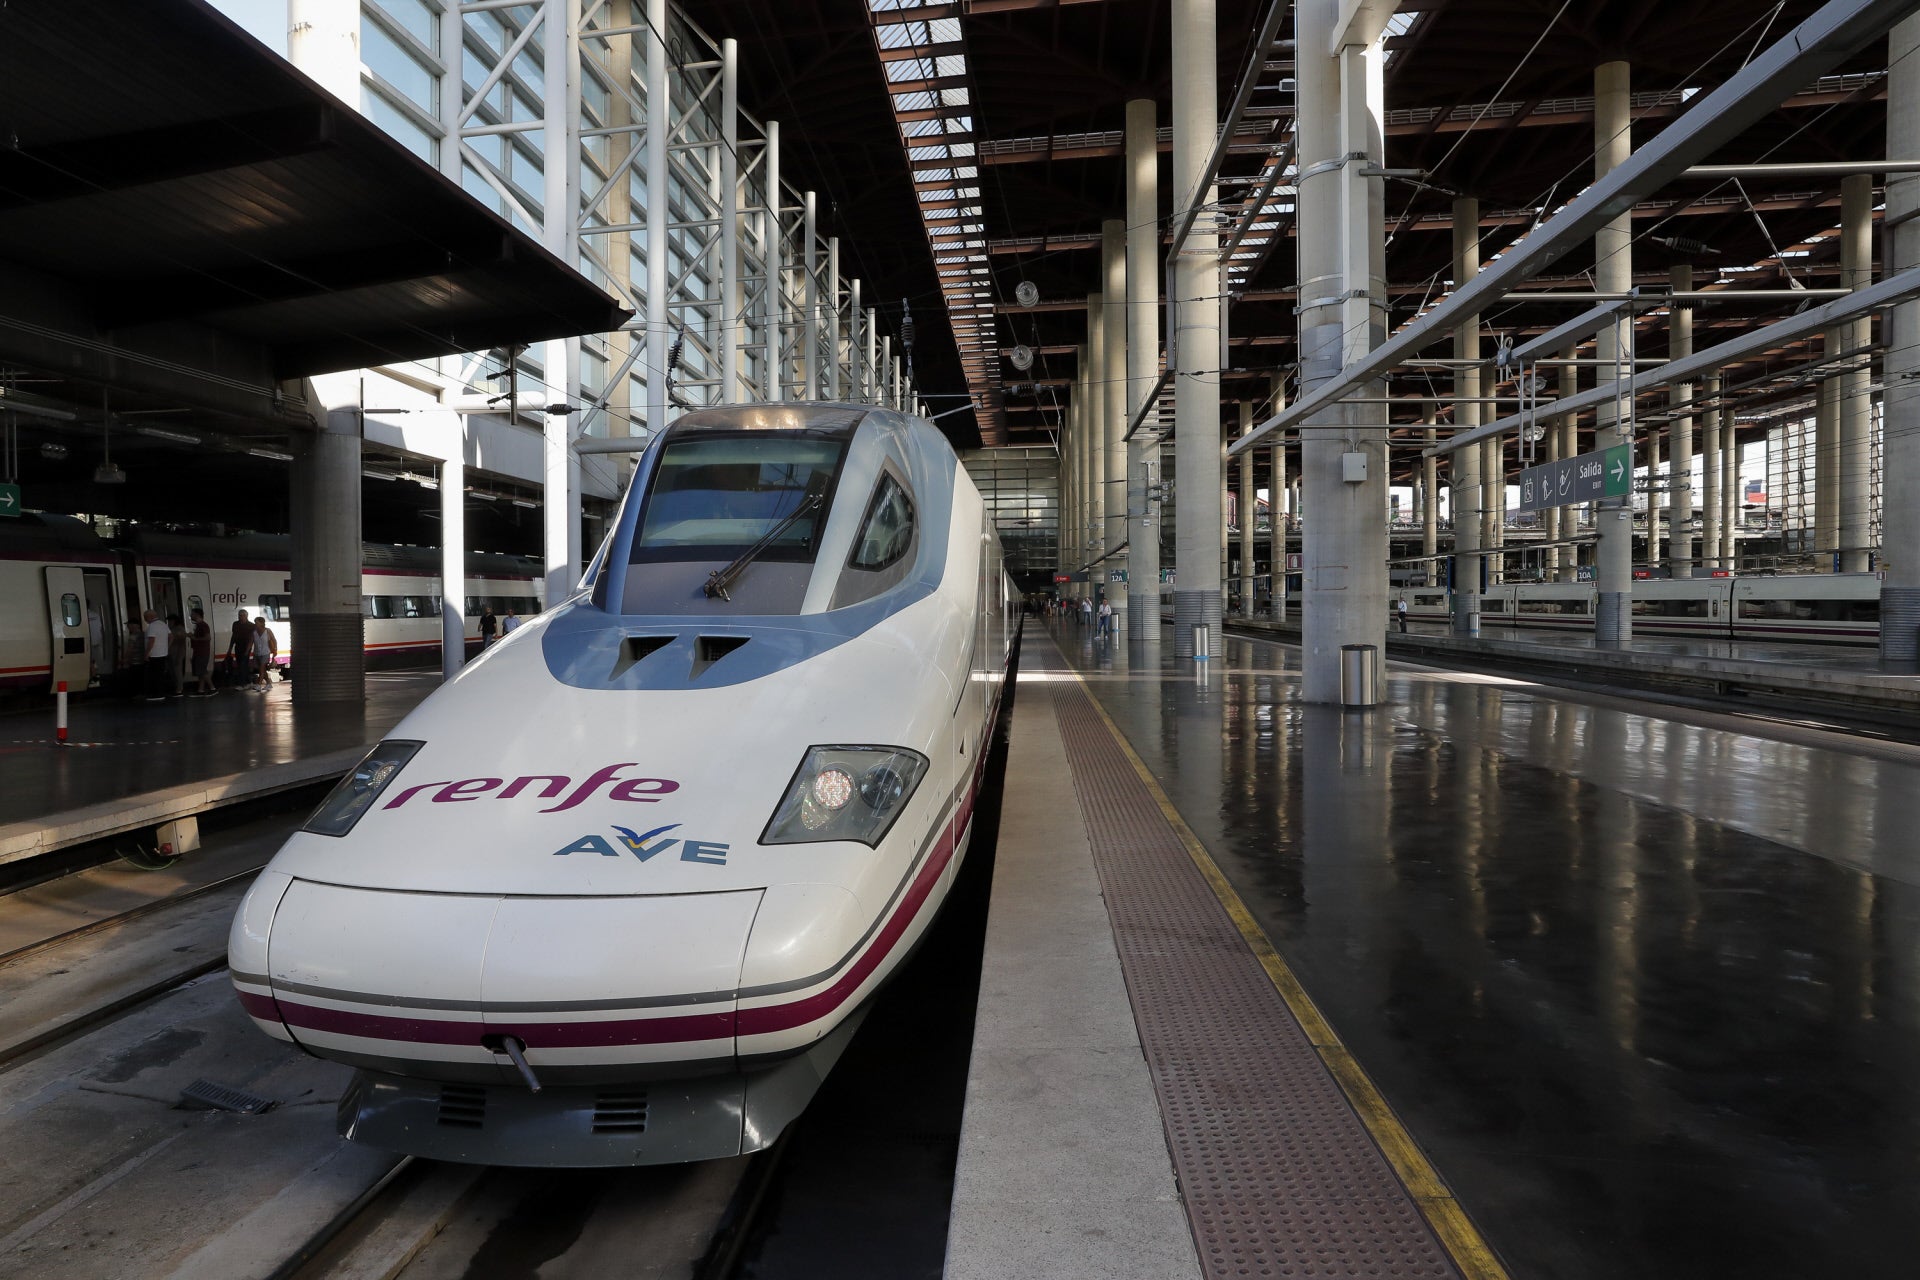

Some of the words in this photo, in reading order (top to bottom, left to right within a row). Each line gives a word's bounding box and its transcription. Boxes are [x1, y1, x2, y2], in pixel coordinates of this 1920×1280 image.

[1580, 461, 1602, 479] Salida
[212, 586, 247, 610] renfe
[382, 762, 680, 813] renfe
[553, 832, 730, 866] AVE
